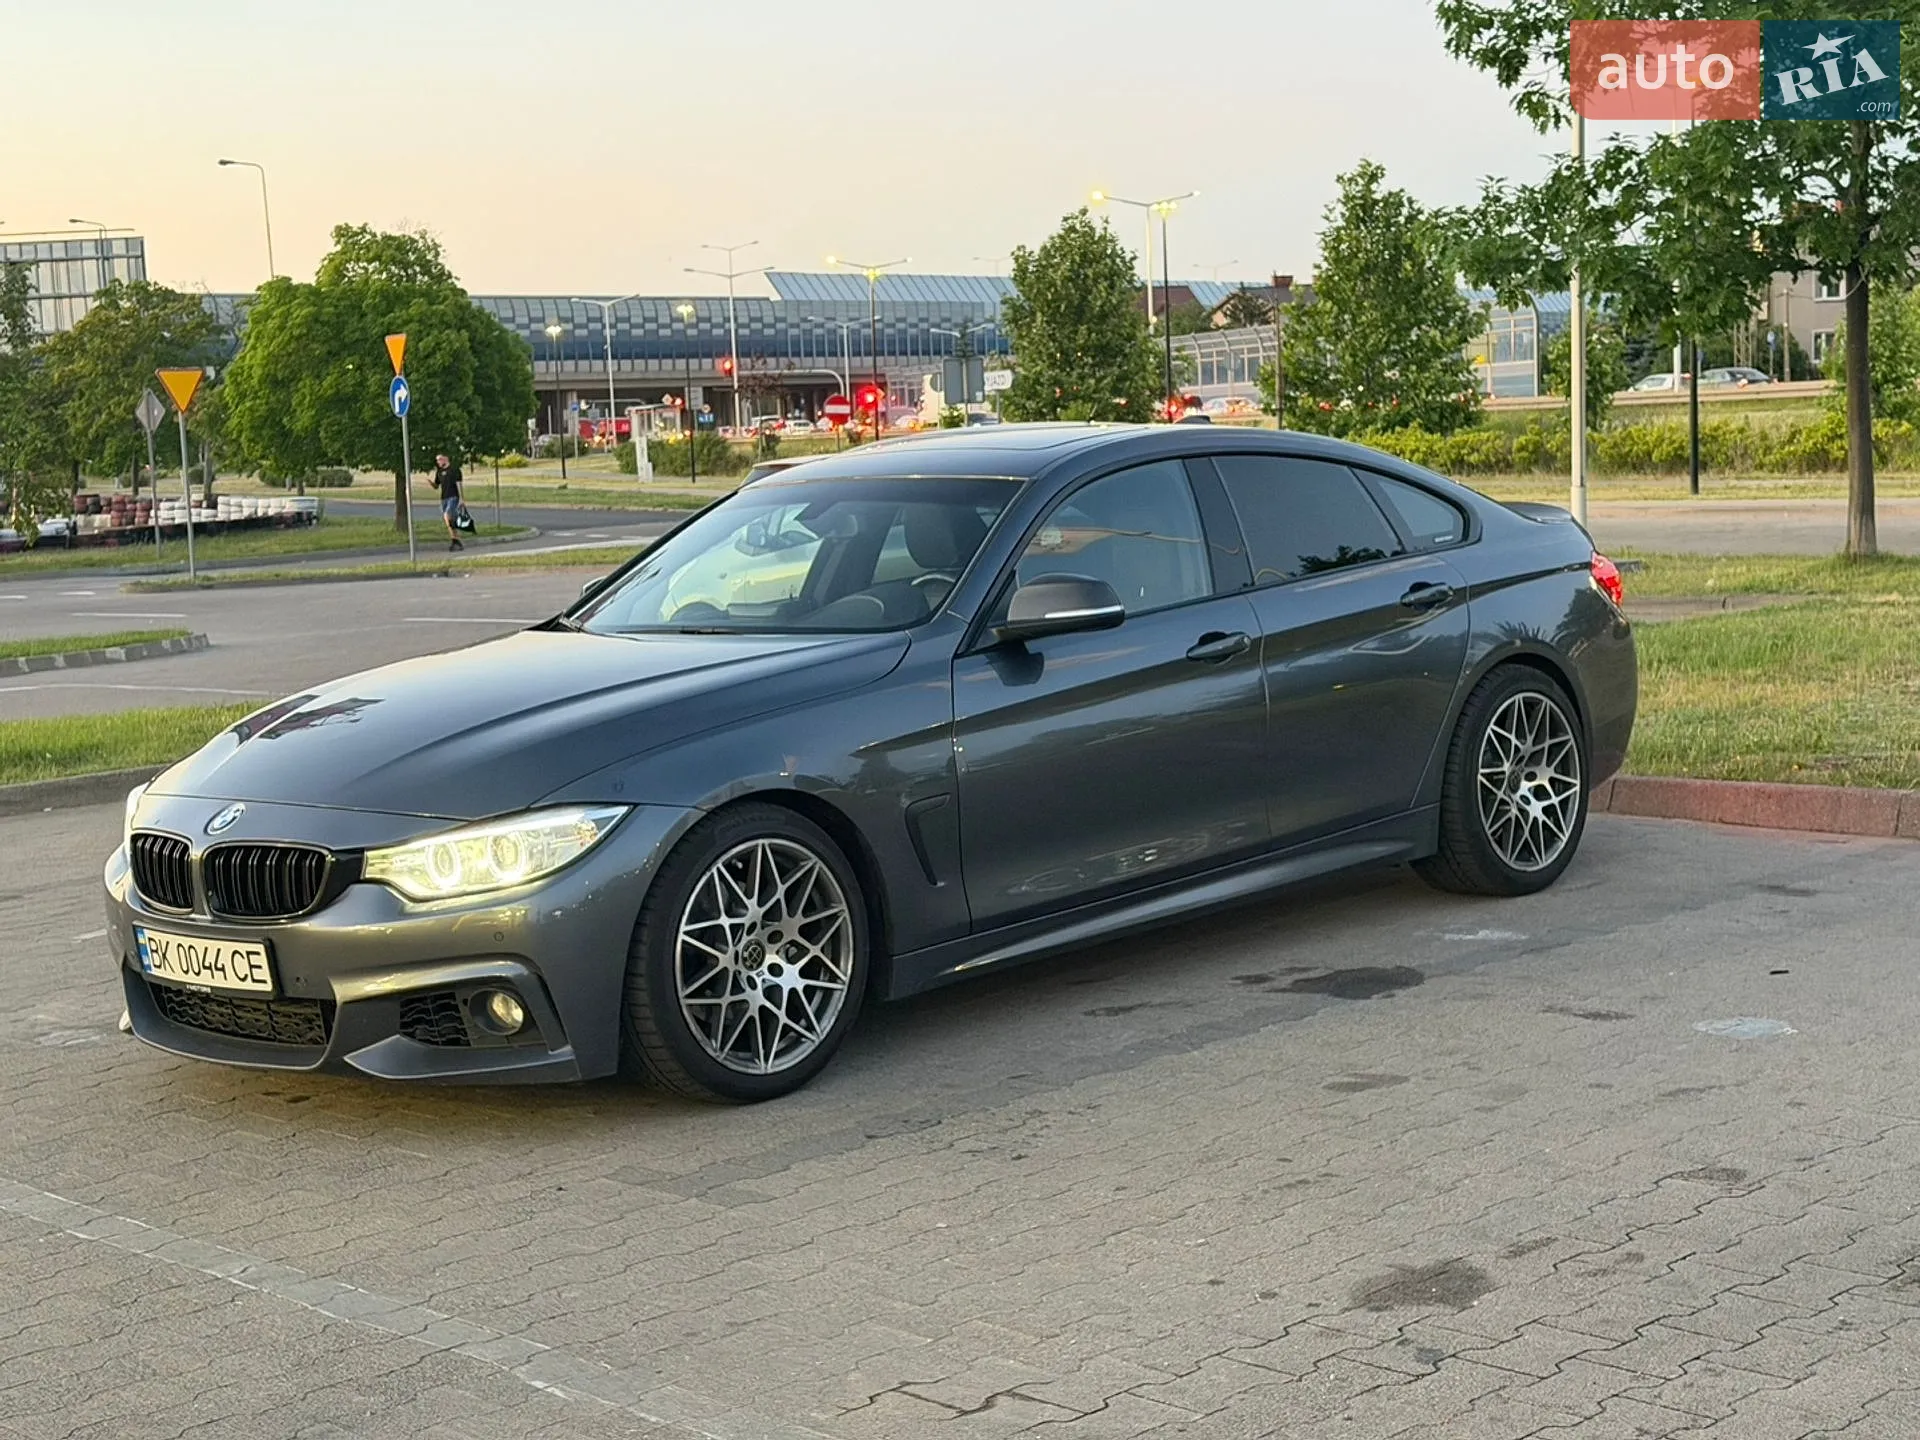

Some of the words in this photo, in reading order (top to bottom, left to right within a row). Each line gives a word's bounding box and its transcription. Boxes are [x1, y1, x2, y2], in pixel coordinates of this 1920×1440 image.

[148, 937, 175, 973] BK
[177, 943, 228, 981] 0044
[232, 950, 268, 984] CE
